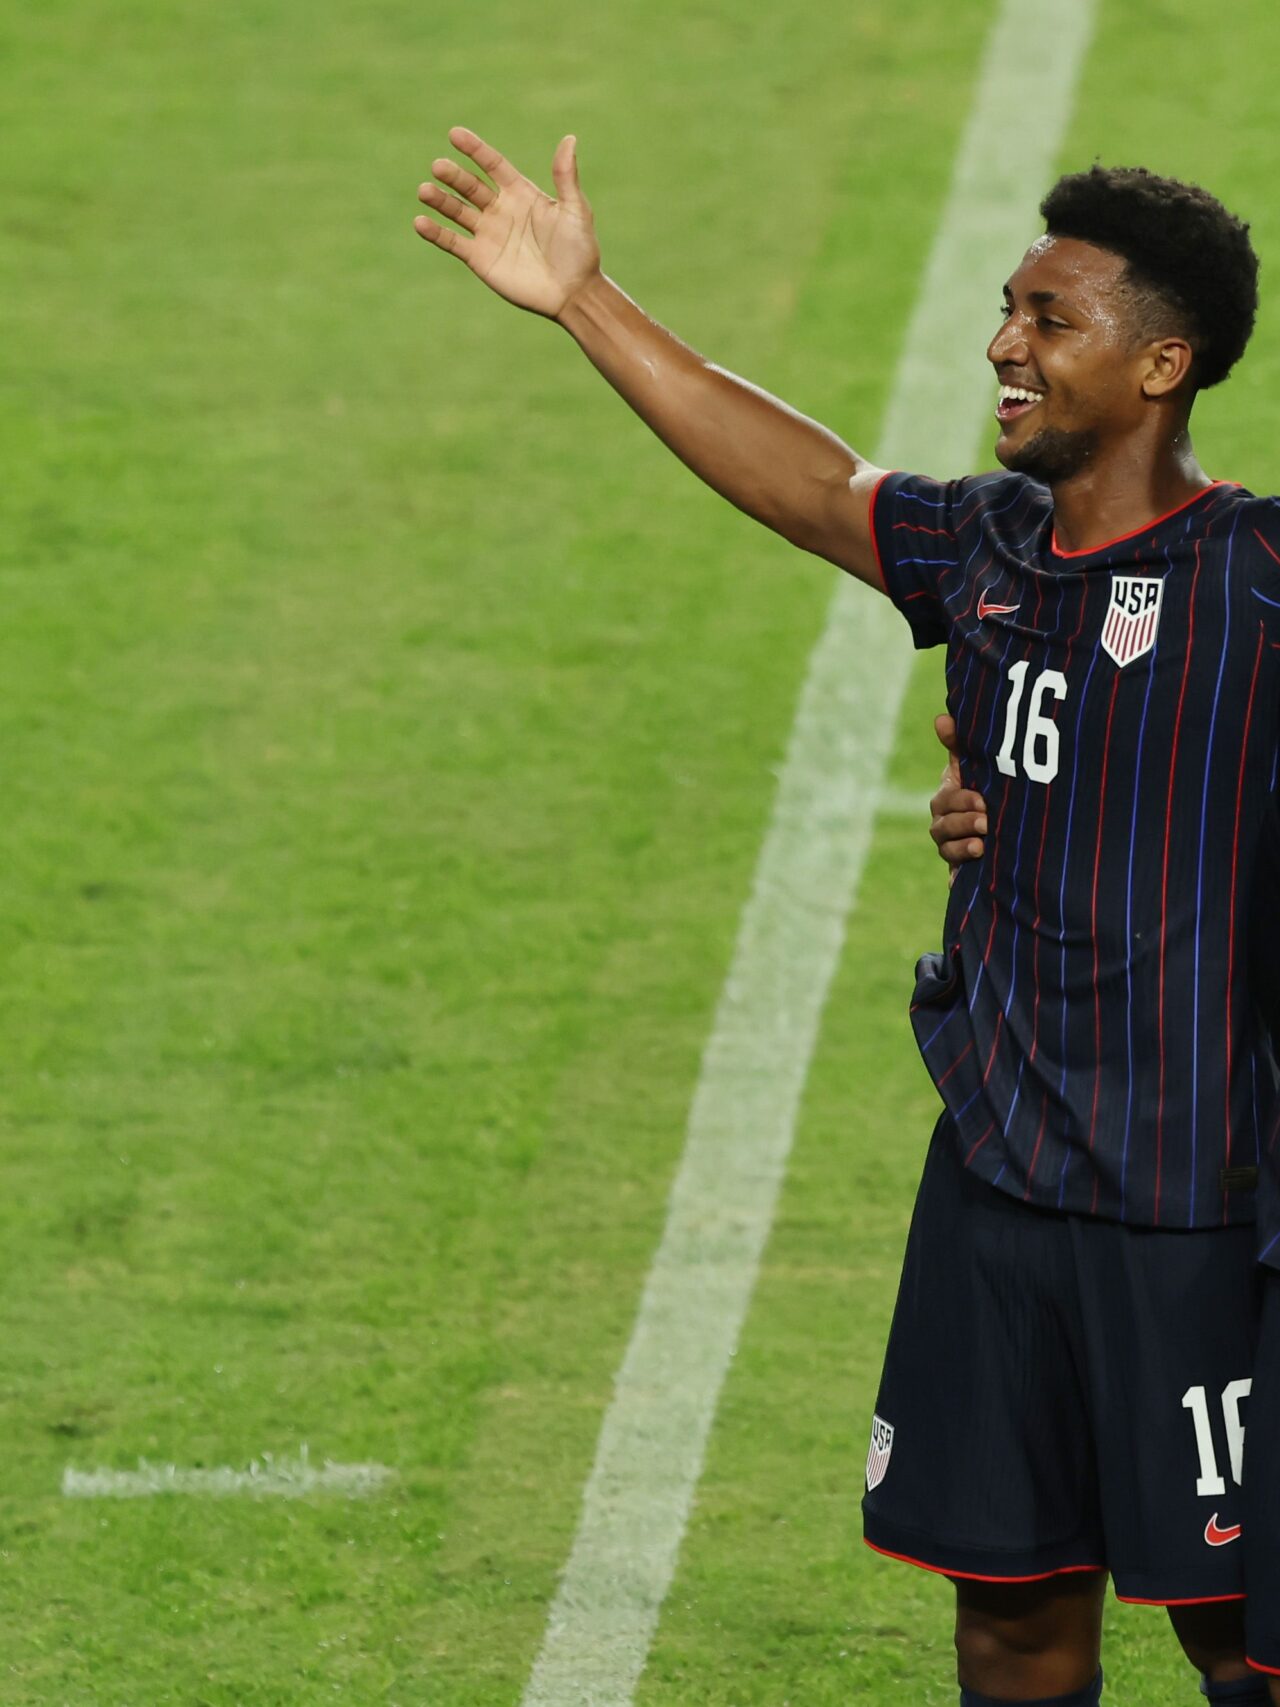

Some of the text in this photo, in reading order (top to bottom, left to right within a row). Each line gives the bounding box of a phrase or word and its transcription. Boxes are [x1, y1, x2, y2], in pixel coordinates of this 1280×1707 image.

[1114, 580, 1159, 616] USA
[995, 660, 1068, 785] 16
[873, 1419, 892, 1452] USA
